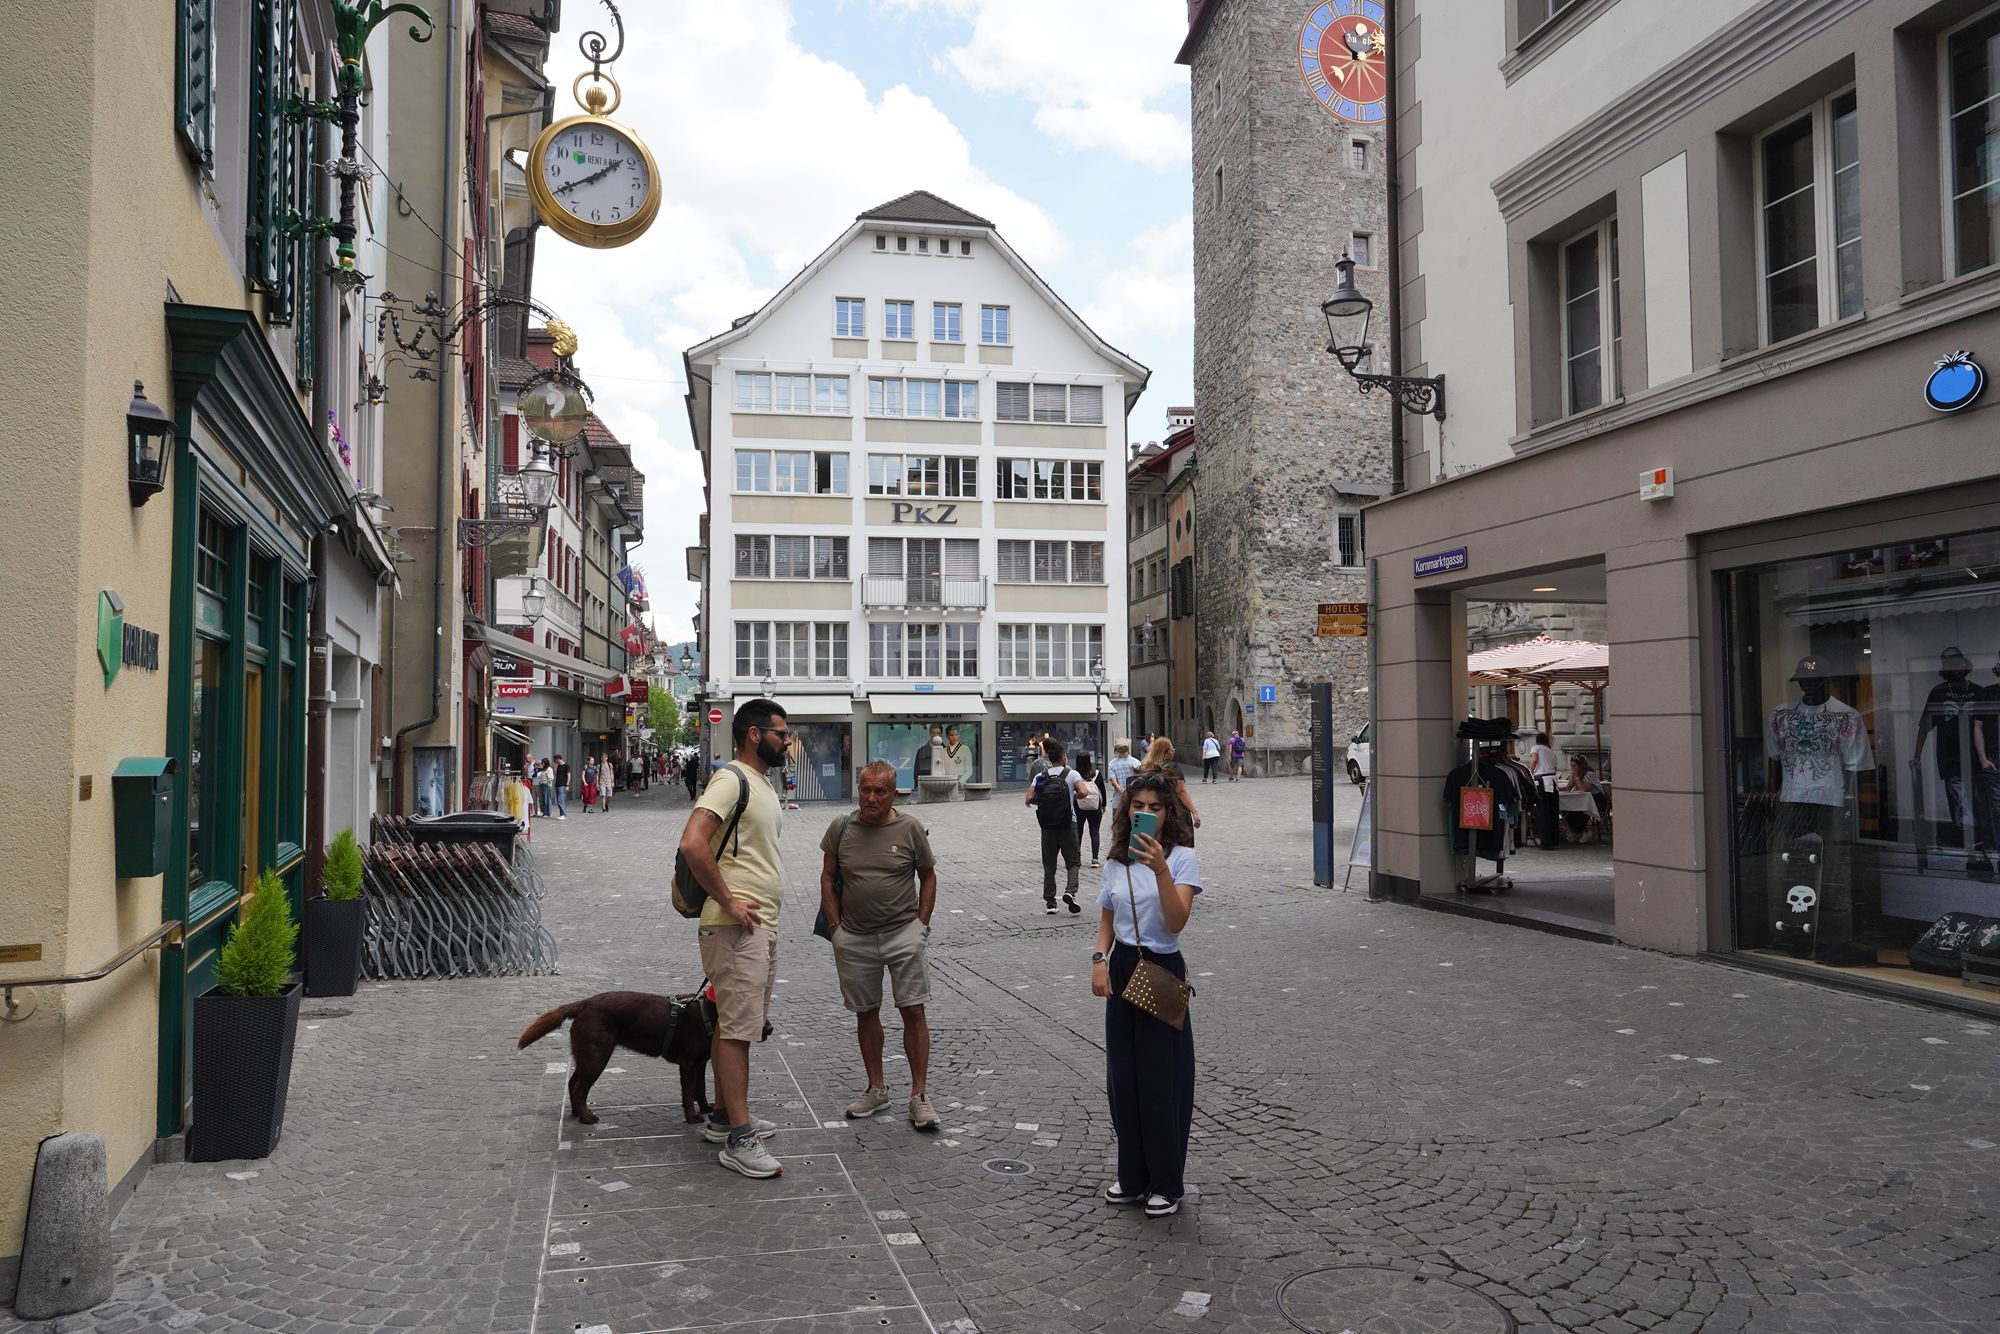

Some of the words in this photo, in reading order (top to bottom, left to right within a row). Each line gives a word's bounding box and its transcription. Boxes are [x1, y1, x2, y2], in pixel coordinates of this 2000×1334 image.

[575, 135, 583, 148] 11
[591, 133, 603, 146] 12
[557, 146, 569, 159] 10
[615, 142, 620, 154] 1
[587, 155, 602, 165] RENT
[603, 157, 608, 165] A
[626, 158, 636, 170] 2
[551, 164, 561, 177] 9
[631, 177, 641, 190] 3
[571, 200, 580, 213] 7
[625, 195, 634, 208] 4
[591, 209, 600, 222] 6
[611, 207, 621, 219] 5
[1000, 556, 1099, 568] Luzen
[1415, 554, 1464, 573] Kornmarktgasse
[1325, 604, 1360, 613] HOTELS
[1340, 627, 1355, 635] Hotel
